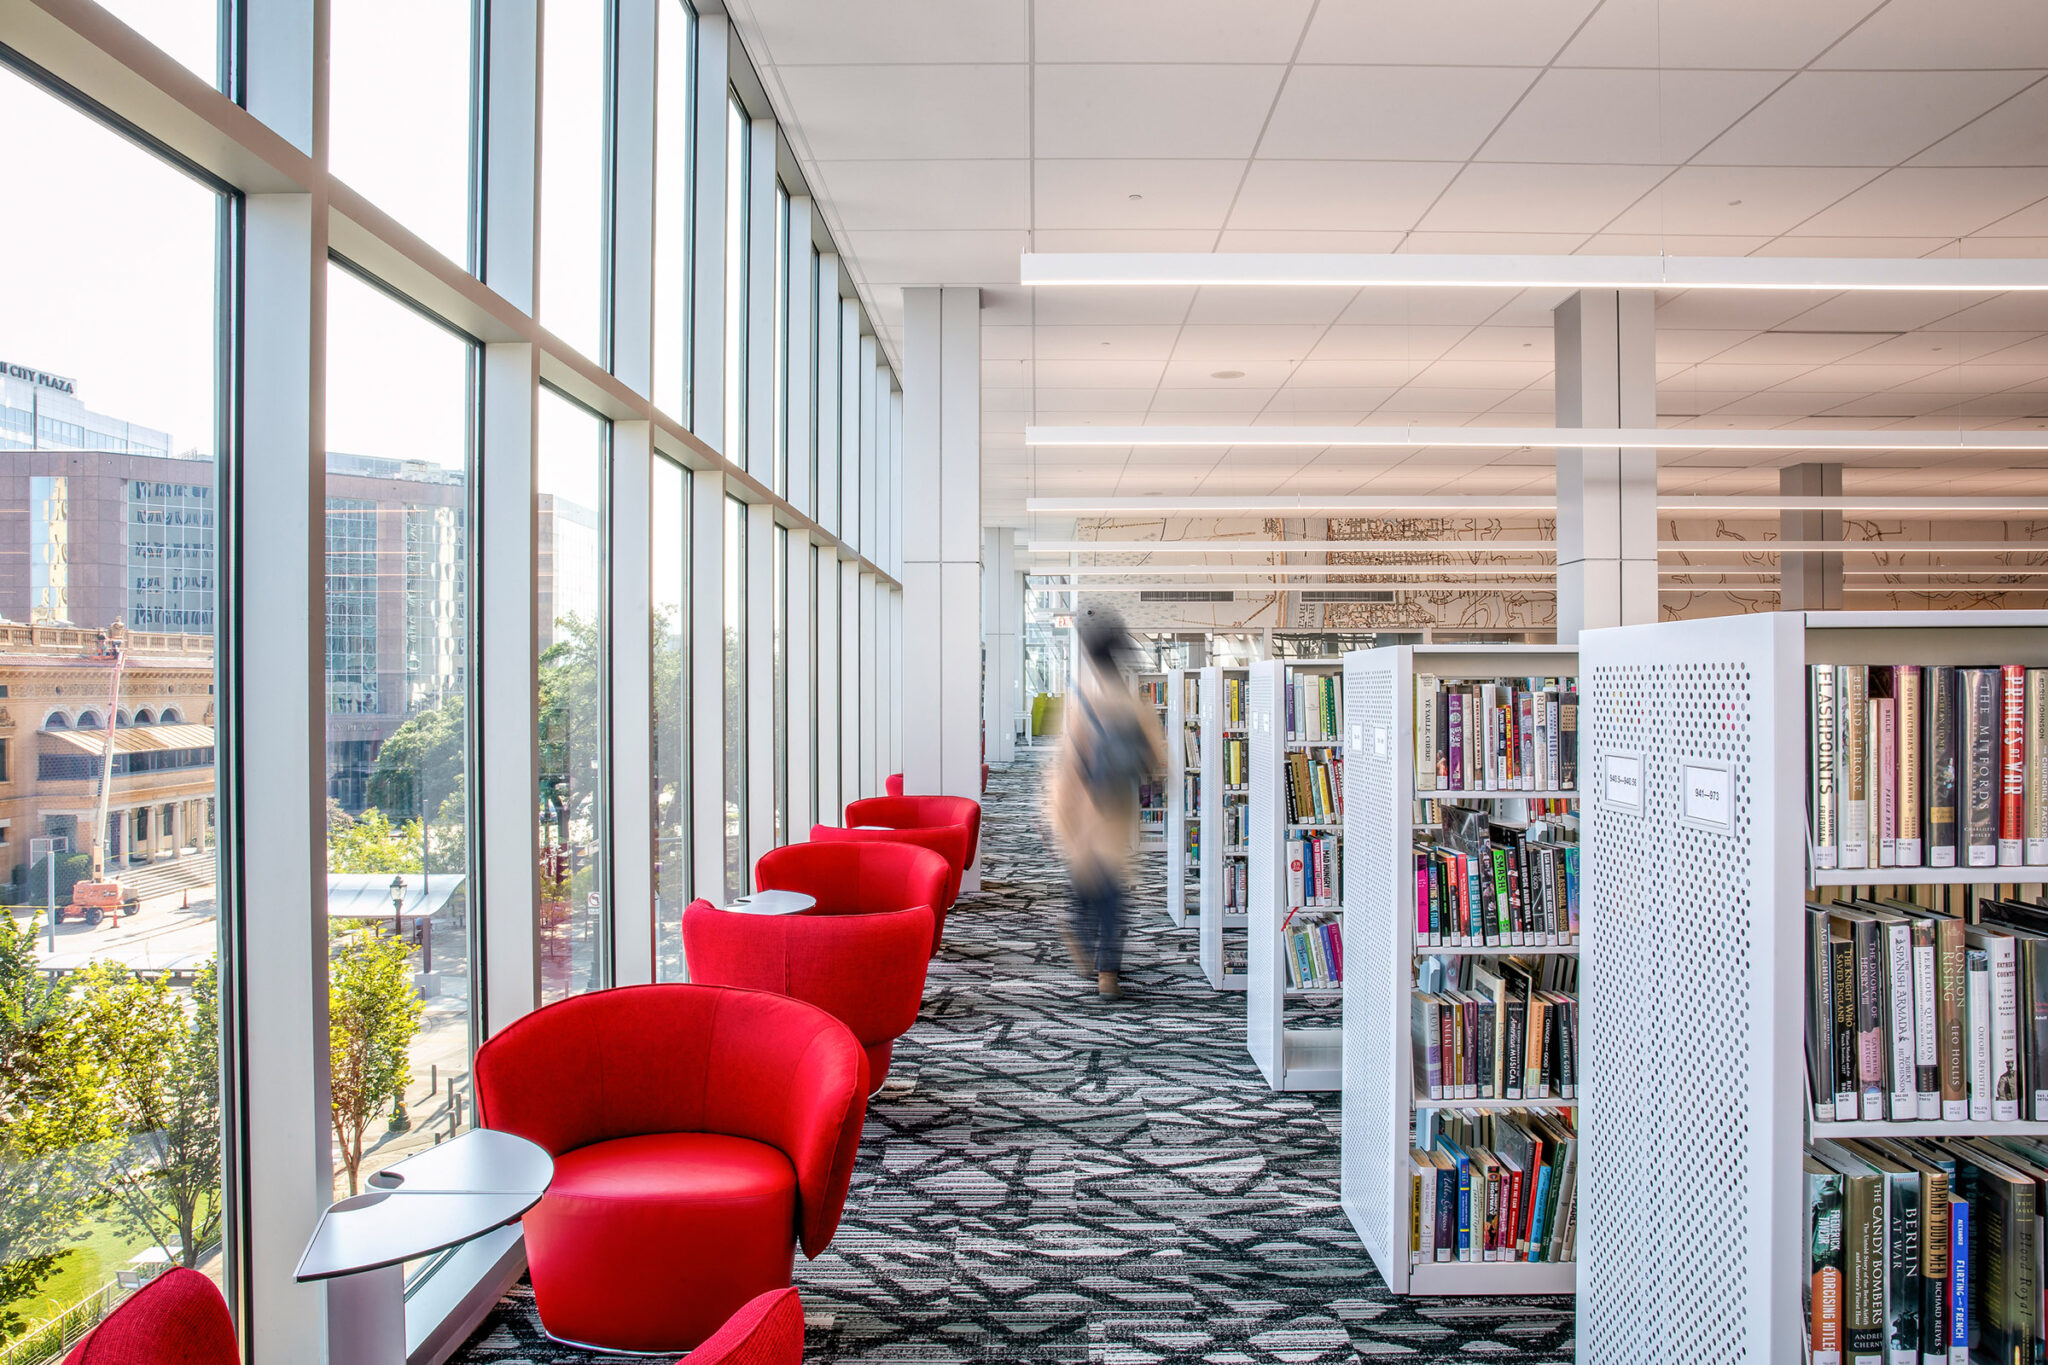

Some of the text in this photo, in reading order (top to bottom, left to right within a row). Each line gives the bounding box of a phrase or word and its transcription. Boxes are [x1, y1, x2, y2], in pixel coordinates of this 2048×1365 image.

[10, 365, 74, 394] CITY PLAZA
[1417, 589, 1453, 598] BATON
[1536, 695, 1545, 725] REBA
[1853, 676, 1862, 726] BEHIND
[1979, 684, 1990, 714] THE
[2003, 675, 2023, 745] PRINCES
[1818, 671, 1834, 796] FLASHPOINTS
[1906, 714, 1914, 751] VICTORIA'S
[1853, 737, 1863, 793] THRONE
[1979, 725, 1991, 810] MITFORDS
[2004, 760, 2023, 795] WAR
[1695, 787, 1720, 802] 941—973
[1323, 864, 1331, 888] HUNGRY
[1495, 855, 1506, 892] SMASH!
[1521, 867, 1529, 888] ROCK
[1430, 899, 1438, 928] PINK FLOYD
[1524, 905, 1532, 923] ROLL
[1557, 869, 1568, 931] CLASSICAL MUSIC
[1547, 913, 1555, 930] GRAVITY
[1820, 928, 1828, 946] AGE
[1836, 954, 1845, 1023] SAVED ENGLAND
[1844, 949, 1855, 1027] THE KNIGHT WHO
[1860, 957, 1869, 1005] HENRY VIII
[1869, 942, 1879, 1019] THE DIVORCE OF
[1895, 945, 1908, 1036] SPANISH ARMADA
[1943, 952, 1955, 1002] RISING
[1955, 945, 1966, 1008] LONDON
[1924, 951, 1935, 1061] PERILOUS QUESTION
[1509, 1016, 1518, 1049] American
[1561, 1025, 1569, 1058] ANYTHING
[1977, 1026, 1986, 1057] OXFORD
[1951, 1025, 1960, 1086] LEO HOLLIS
[1978, 1059, 1987, 1098] REVISITED
[1439, 1176, 1455, 1232] Hello, Gorgeous
[1818, 1217, 1830, 1244] TAYLOR
[1829, 1209, 1840, 1251] FREDERICK
[1893, 1217, 1902, 1269] AT WAR
[1905, 1208, 1918, 1278] BERLIN
[1930, 1179, 1948, 1274] DARING YOUNG MEN
[1862, 1255, 1870, 1271] Story
[1872, 1183, 1883, 1325] THE CANDY BOMBERS
[2019, 1232, 2033, 1273] Blood
[1956, 1259, 1966, 1296] FLIRTING
[2014, 1276, 2033, 1317] Royal
[1822, 1265, 1837, 1352] EXORCISING HITLER
[1934, 1281, 1942, 1347] RICHARD REEVES
[1955, 1307, 1965, 1339] FRENCH
[1853, 1341, 1883, 1349] CHERNY
